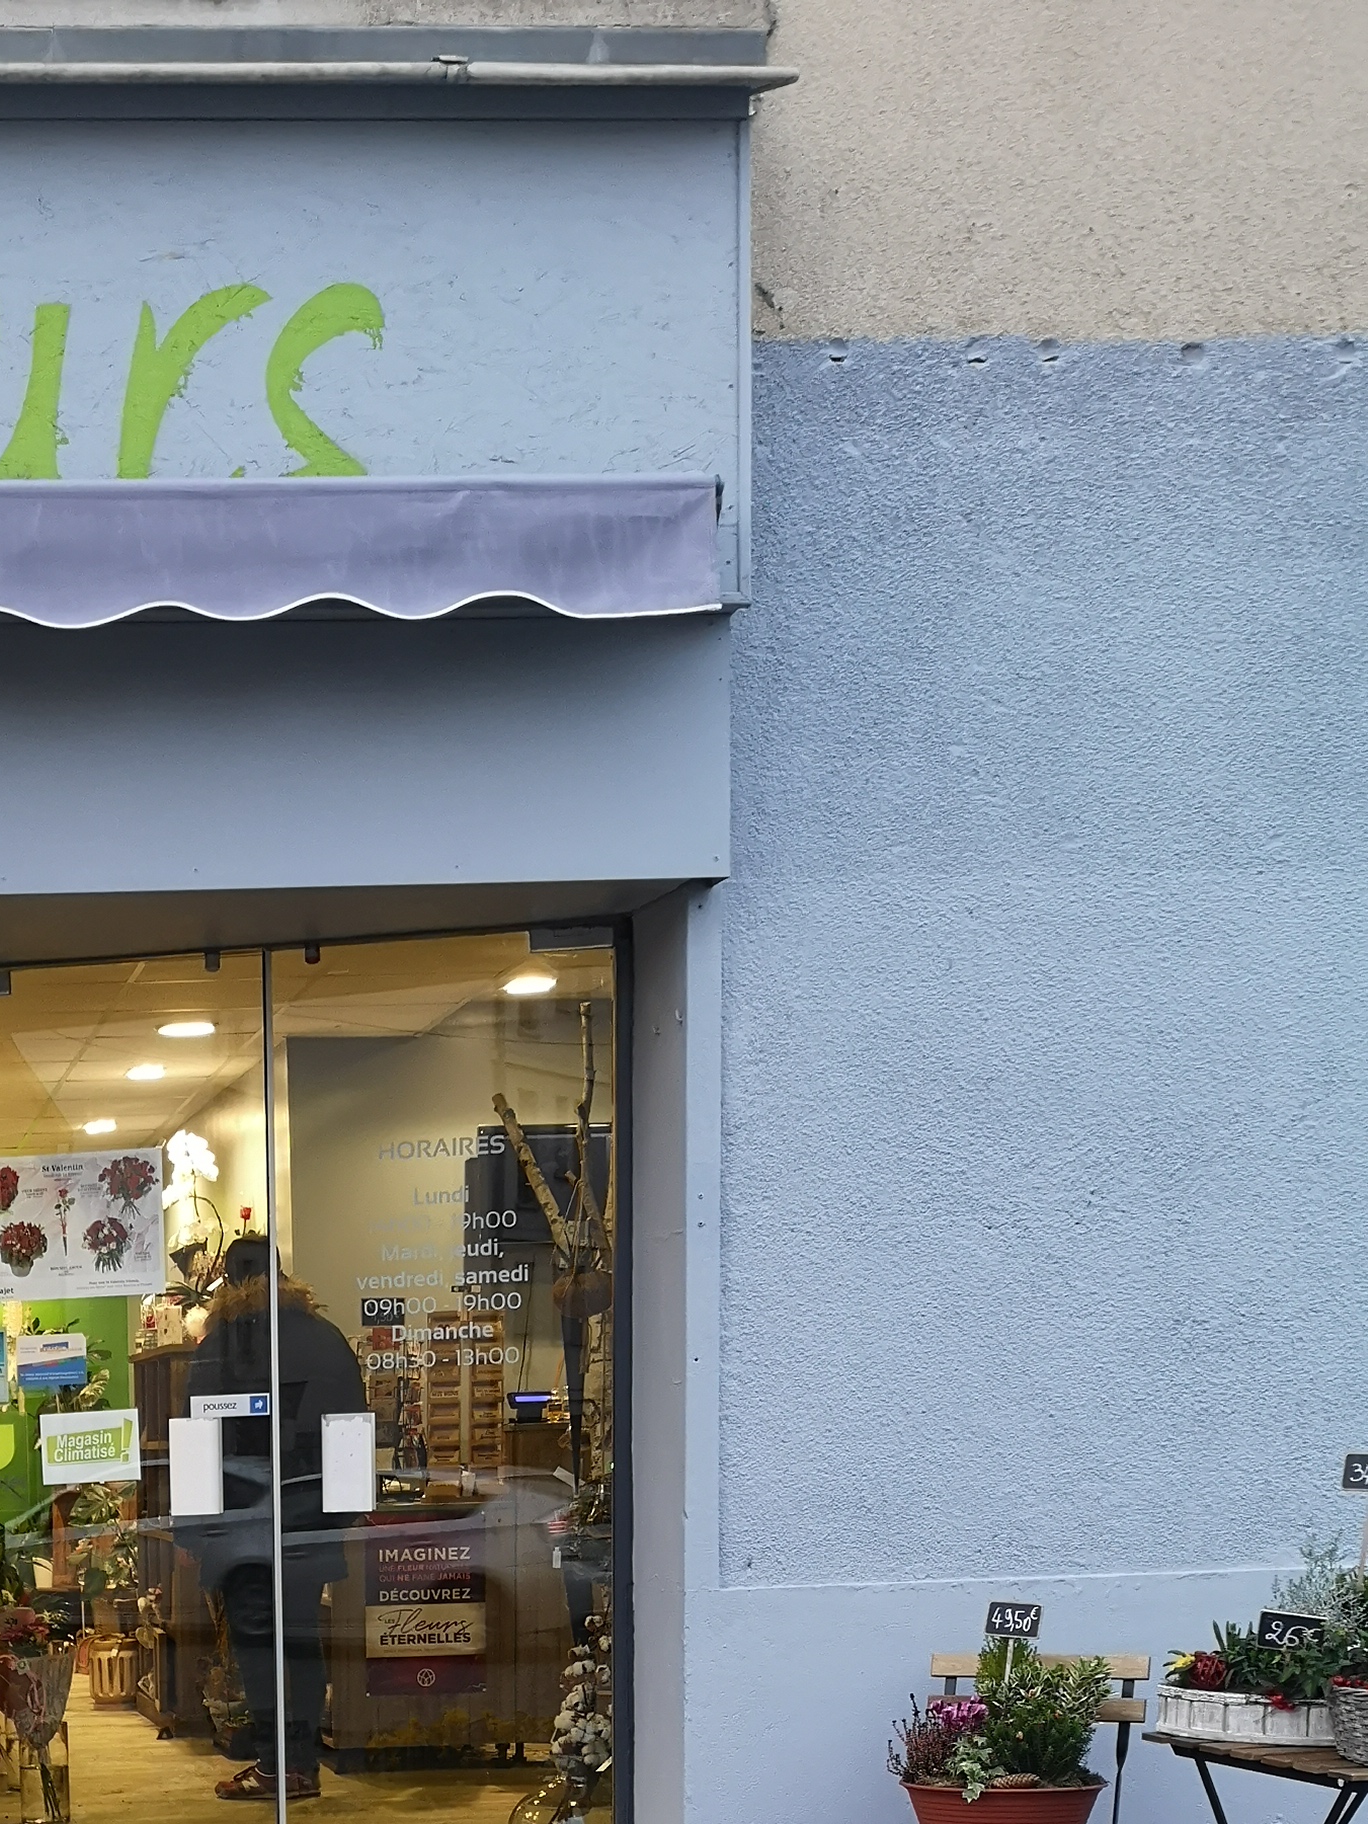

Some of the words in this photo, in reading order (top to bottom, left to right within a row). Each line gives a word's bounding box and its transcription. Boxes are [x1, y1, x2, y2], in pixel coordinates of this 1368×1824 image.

[378, 1135, 506, 1160] HORAIRES
[51, 1163, 83, 1171] Valentin
[413, 1185, 470, 1205] Lundi
[356, 1270, 451, 1290] vendredi,
[454, 1264, 529, 1285] samedi
[364, 1297, 436, 1316] 09h00
[456, 1292, 522, 1312] 19h00
[392, 1322, 494, 1342] Dimanche
[366, 1350, 436, 1370] 08h30
[455, 1347, 520, 1366] 13h00
[203, 1402, 237, 1413] poussez
[56, 1433, 112, 1450] Magasin
[54, 1444, 116, 1463] Climatisé
[379, 1547, 471, 1562] IMAGINEZ
[438, 1572, 471, 1580] JAMAIS
[379, 1588, 471, 1602] DÉCOUVREZ
[378, 1608, 473, 1637] Fleurs
[991, 1606, 1039, 1632] 49,50€
[380, 1633, 471, 1646] ÉTERNELLES
